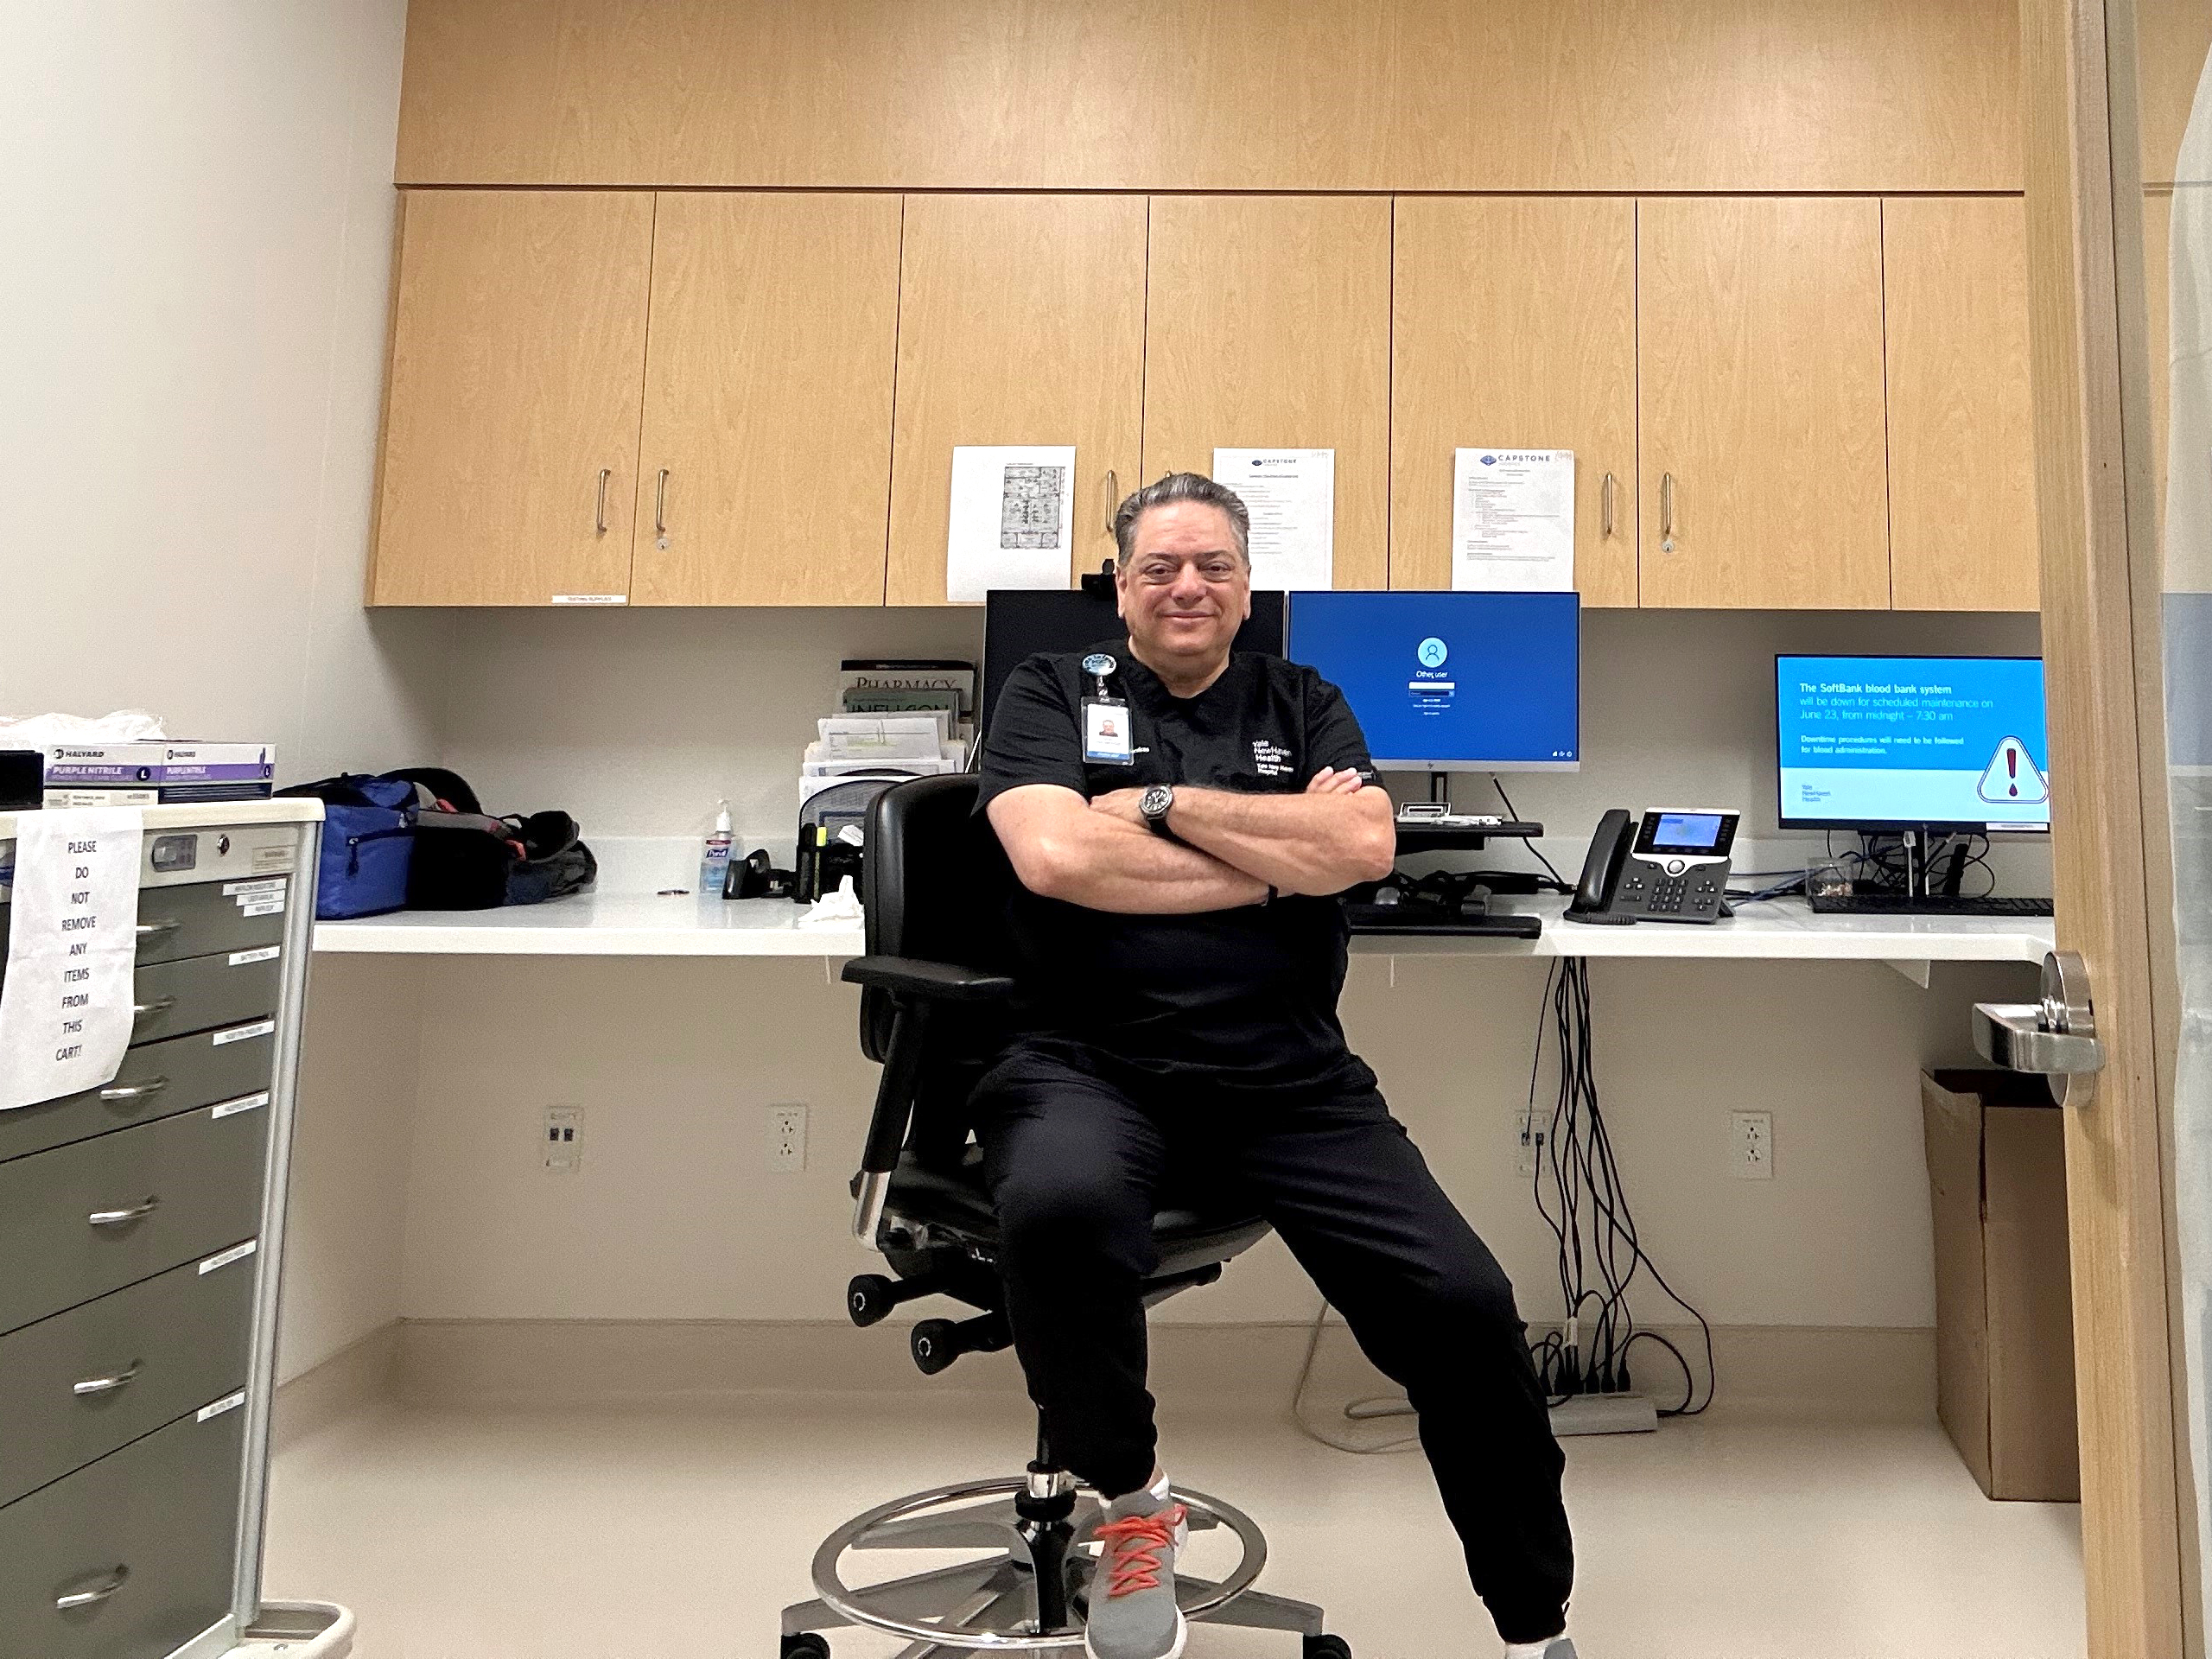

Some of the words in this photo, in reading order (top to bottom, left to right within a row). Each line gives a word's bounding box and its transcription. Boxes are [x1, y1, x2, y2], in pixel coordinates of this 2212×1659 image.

[855, 677, 957, 689] PHARMACY
[1800, 683, 1816, 693] The
[1820, 683, 1863, 694] SoftBank
[1866, 683, 1891, 694] blood
[1894, 684, 1917, 694] bank
[1920, 685, 1952, 696] system
[1800, 697, 1814, 706] will
[1817, 697, 1827, 706] be
[1831, 697, 1855, 707] down
[1858, 697, 1869, 707] for
[1872, 697, 1919, 708] scheduled
[1922, 698, 1979, 708] maintenance
[1800, 709, 1821, 720] June
[1824, 709, 1840, 721] 23,
[1842, 709, 1863, 720] from
[1866, 710, 1905, 722] midnight
[1916, 710, 1936, 721] 7:30
[52, 766, 86, 775] PURPLE
[87, 766, 123, 775] NITRILE
[68, 841, 97, 854] PLEASE
[75, 867, 89, 879] DO
[71, 892, 90, 904] NOT
[61, 916, 97, 931] REMOVE
[69, 943, 87, 956] ANY
[64, 968, 90, 982] ITEMS
[62, 994, 89, 1009] FROM
[62, 1020, 83, 1034] THIS
[56, 1045, 82, 1061] CART!
